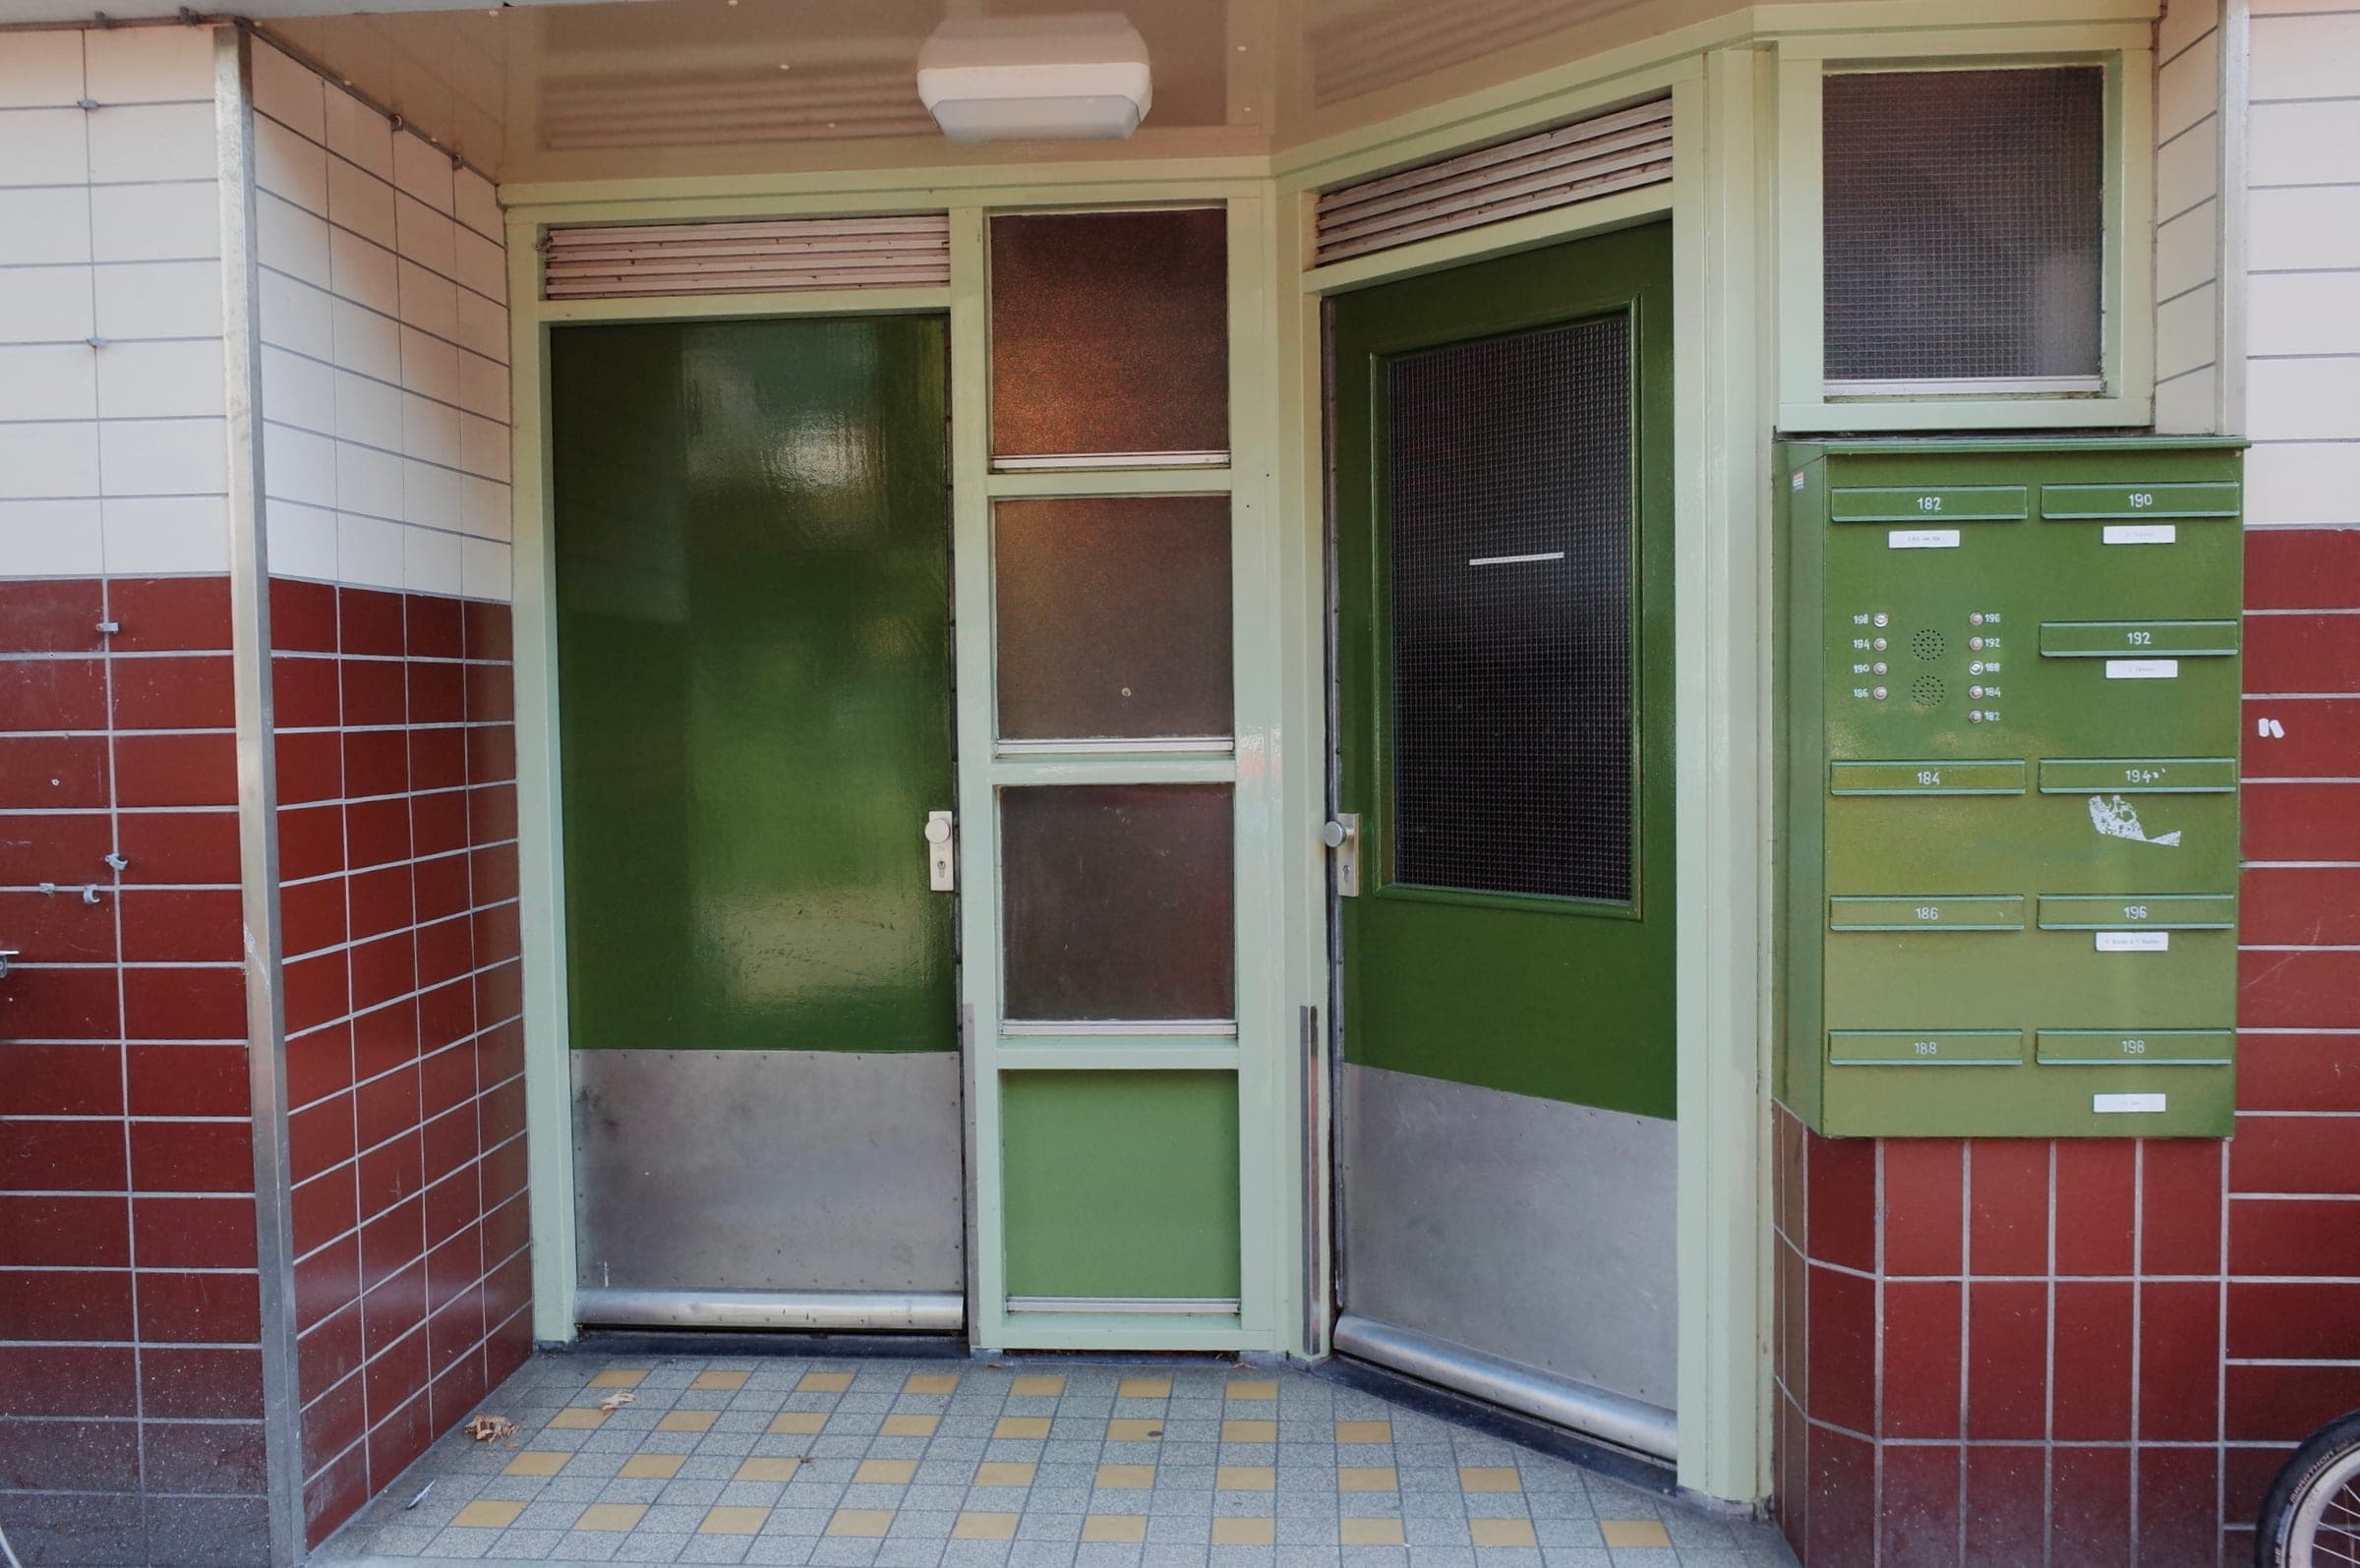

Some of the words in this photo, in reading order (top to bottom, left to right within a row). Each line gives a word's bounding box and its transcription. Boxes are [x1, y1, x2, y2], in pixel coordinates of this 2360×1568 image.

[1918, 497, 1941, 510] 182
[2129, 494, 2153, 507] 190
[1853, 612, 1869, 625] 198
[1984, 612, 2001, 623] 196
[1853, 638, 1870, 651] 194
[1984, 637, 2001, 648] 192
[2128, 632, 2151, 645] 192
[1853, 664, 1870, 674] 190
[1983, 686, 2001, 698] 184
[1983, 710, 2000, 722] 182
[1918, 772, 1939, 784] 184
[1916, 907, 1938, 920] 186
[2124, 905, 2147, 919] 196
[1915, 1042, 1936, 1054] 188
[2122, 1040, 2145, 1054] 198
[2289, 1449, 2335, 1504] MARATHON
